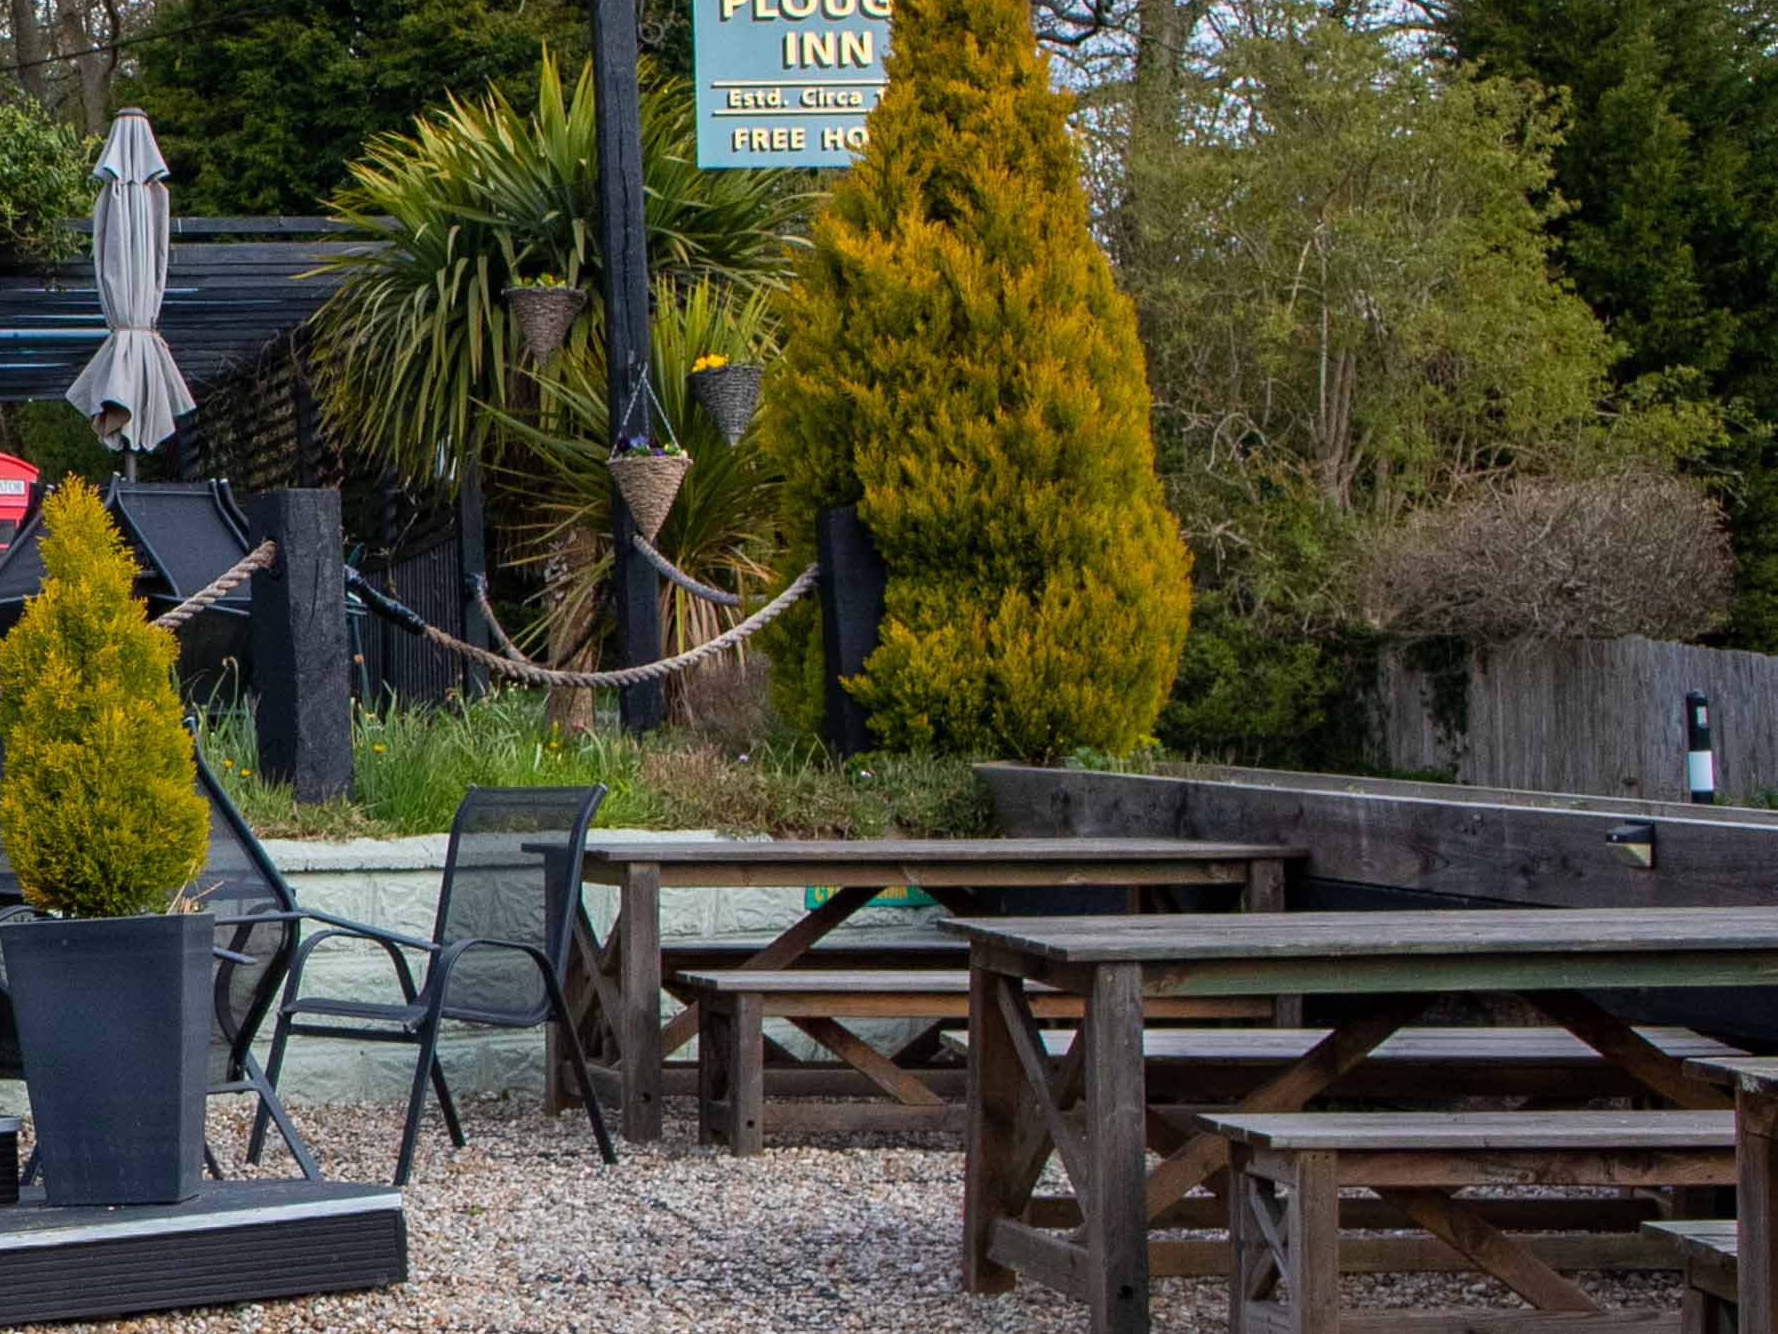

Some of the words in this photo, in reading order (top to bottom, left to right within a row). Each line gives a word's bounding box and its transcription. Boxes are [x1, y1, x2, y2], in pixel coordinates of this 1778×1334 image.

[784, 30, 874, 68] INN
[728, 87, 790, 107] Estd.
[801, 87, 863, 107] Circa
[734, 126, 806, 150] FREE
